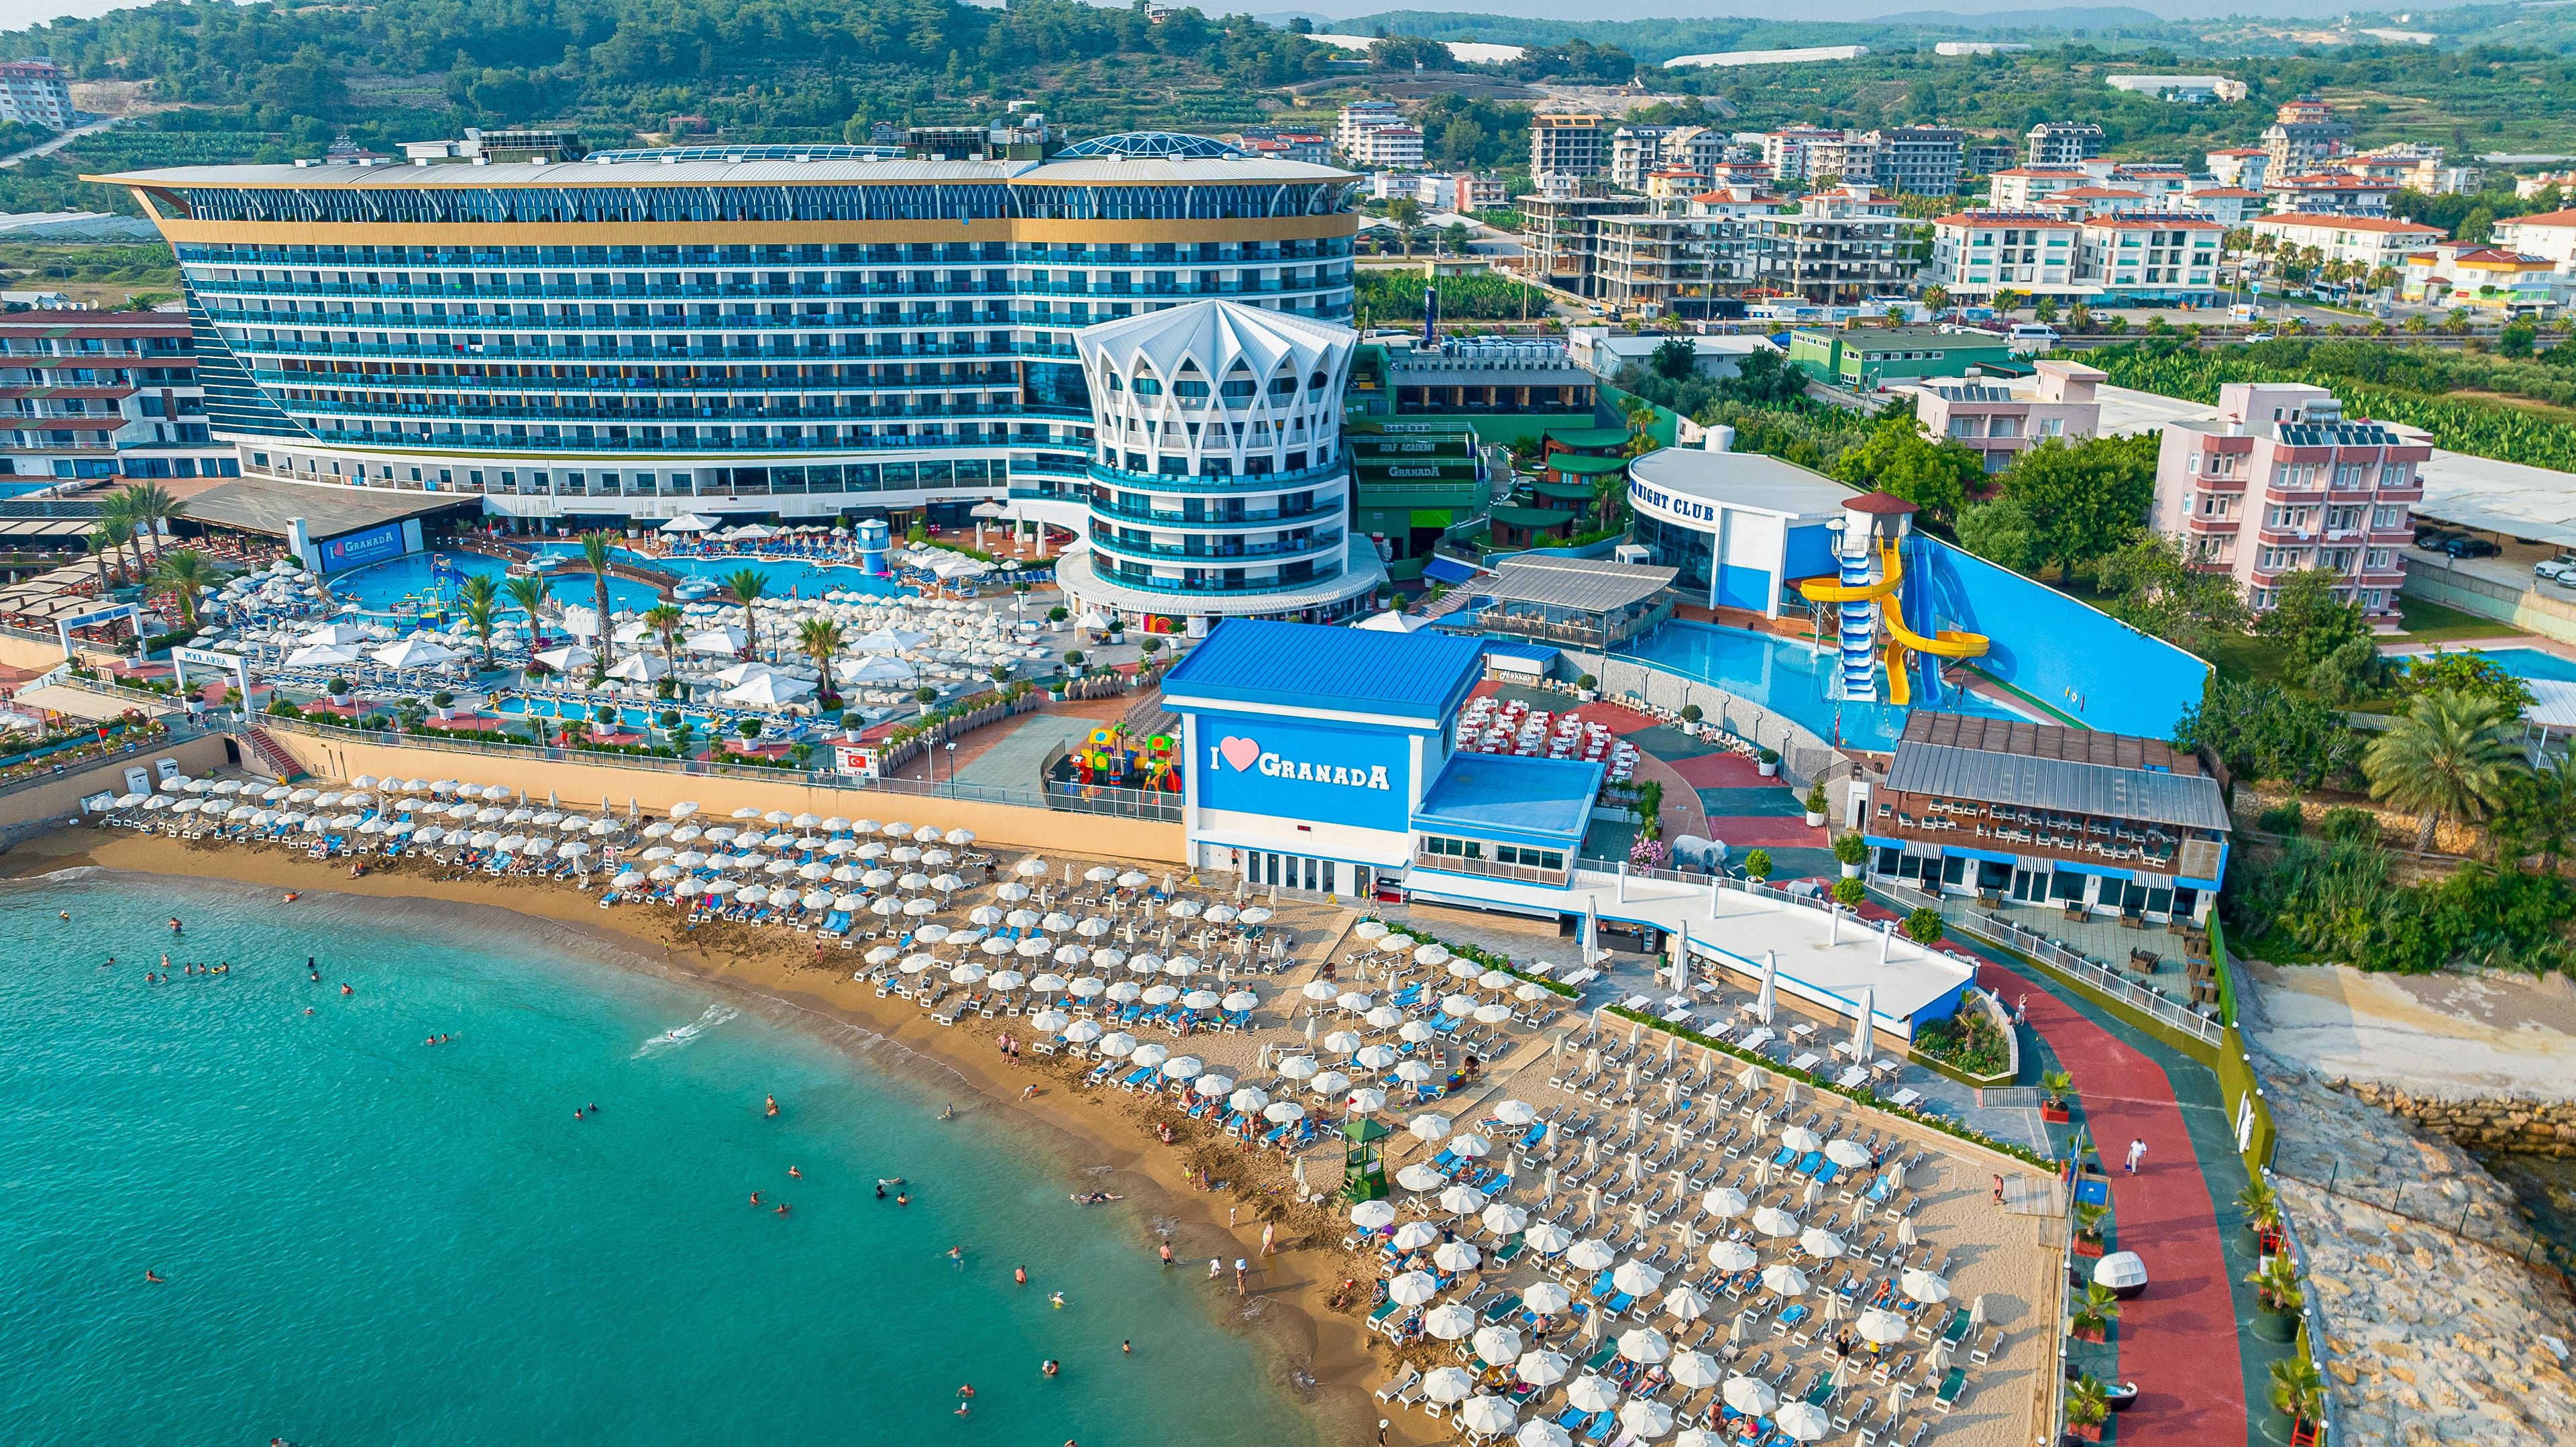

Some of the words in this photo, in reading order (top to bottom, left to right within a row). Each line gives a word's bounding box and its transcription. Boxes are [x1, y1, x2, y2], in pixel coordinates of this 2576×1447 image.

[1380, 443, 1398, 451] GOLF
[1401, 443, 1436, 451] ACADEMY
[1389, 466, 1440, 477] GRANADA
[1638, 483, 1669, 510] NIGHT
[1673, 498, 1714, 521] CLUB
[329, 546, 335, 559] I
[345, 531, 394, 551] GRANADA
[184, 651, 205, 662] POOL
[206, 655, 227, 666] AREA
[1210, 746, 1220, 770] I
[1258, 751, 1391, 791] GRANADA
